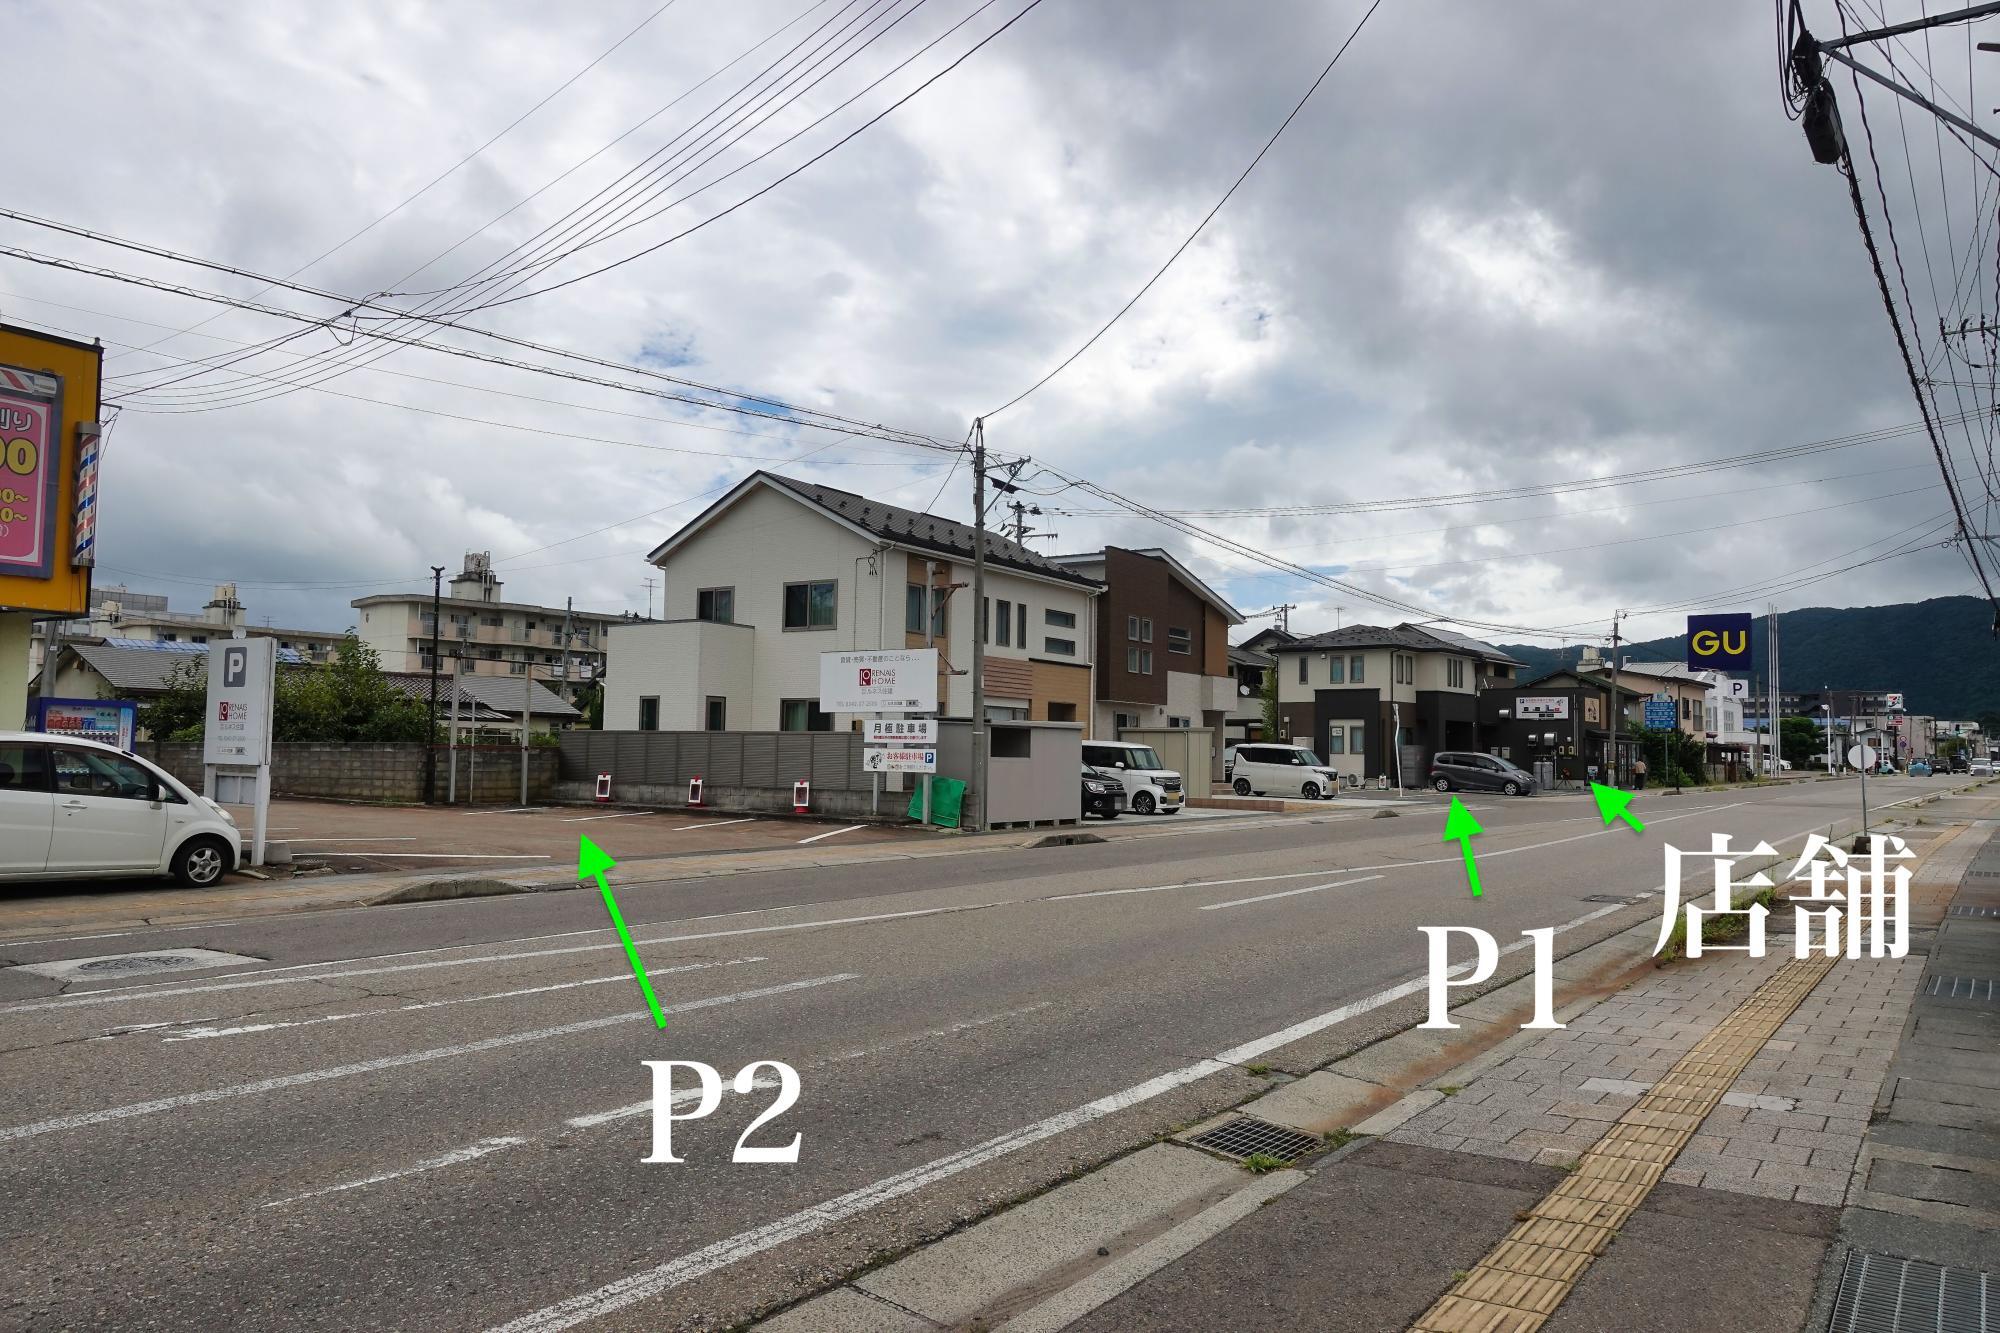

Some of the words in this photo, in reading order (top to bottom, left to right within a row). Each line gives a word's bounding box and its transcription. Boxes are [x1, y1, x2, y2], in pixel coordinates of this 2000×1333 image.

[0, 437, 38, 475] 0
[1692, 630, 1746, 656] GU
[228, 652, 244, 682] P
[871, 669, 896, 677] RENAIS
[1733, 683, 1743, 696] P
[228, 703, 248, 711] RENAIS
[228, 711, 248, 720] HOME
[873, 722, 927, 734] 月極駐車場
